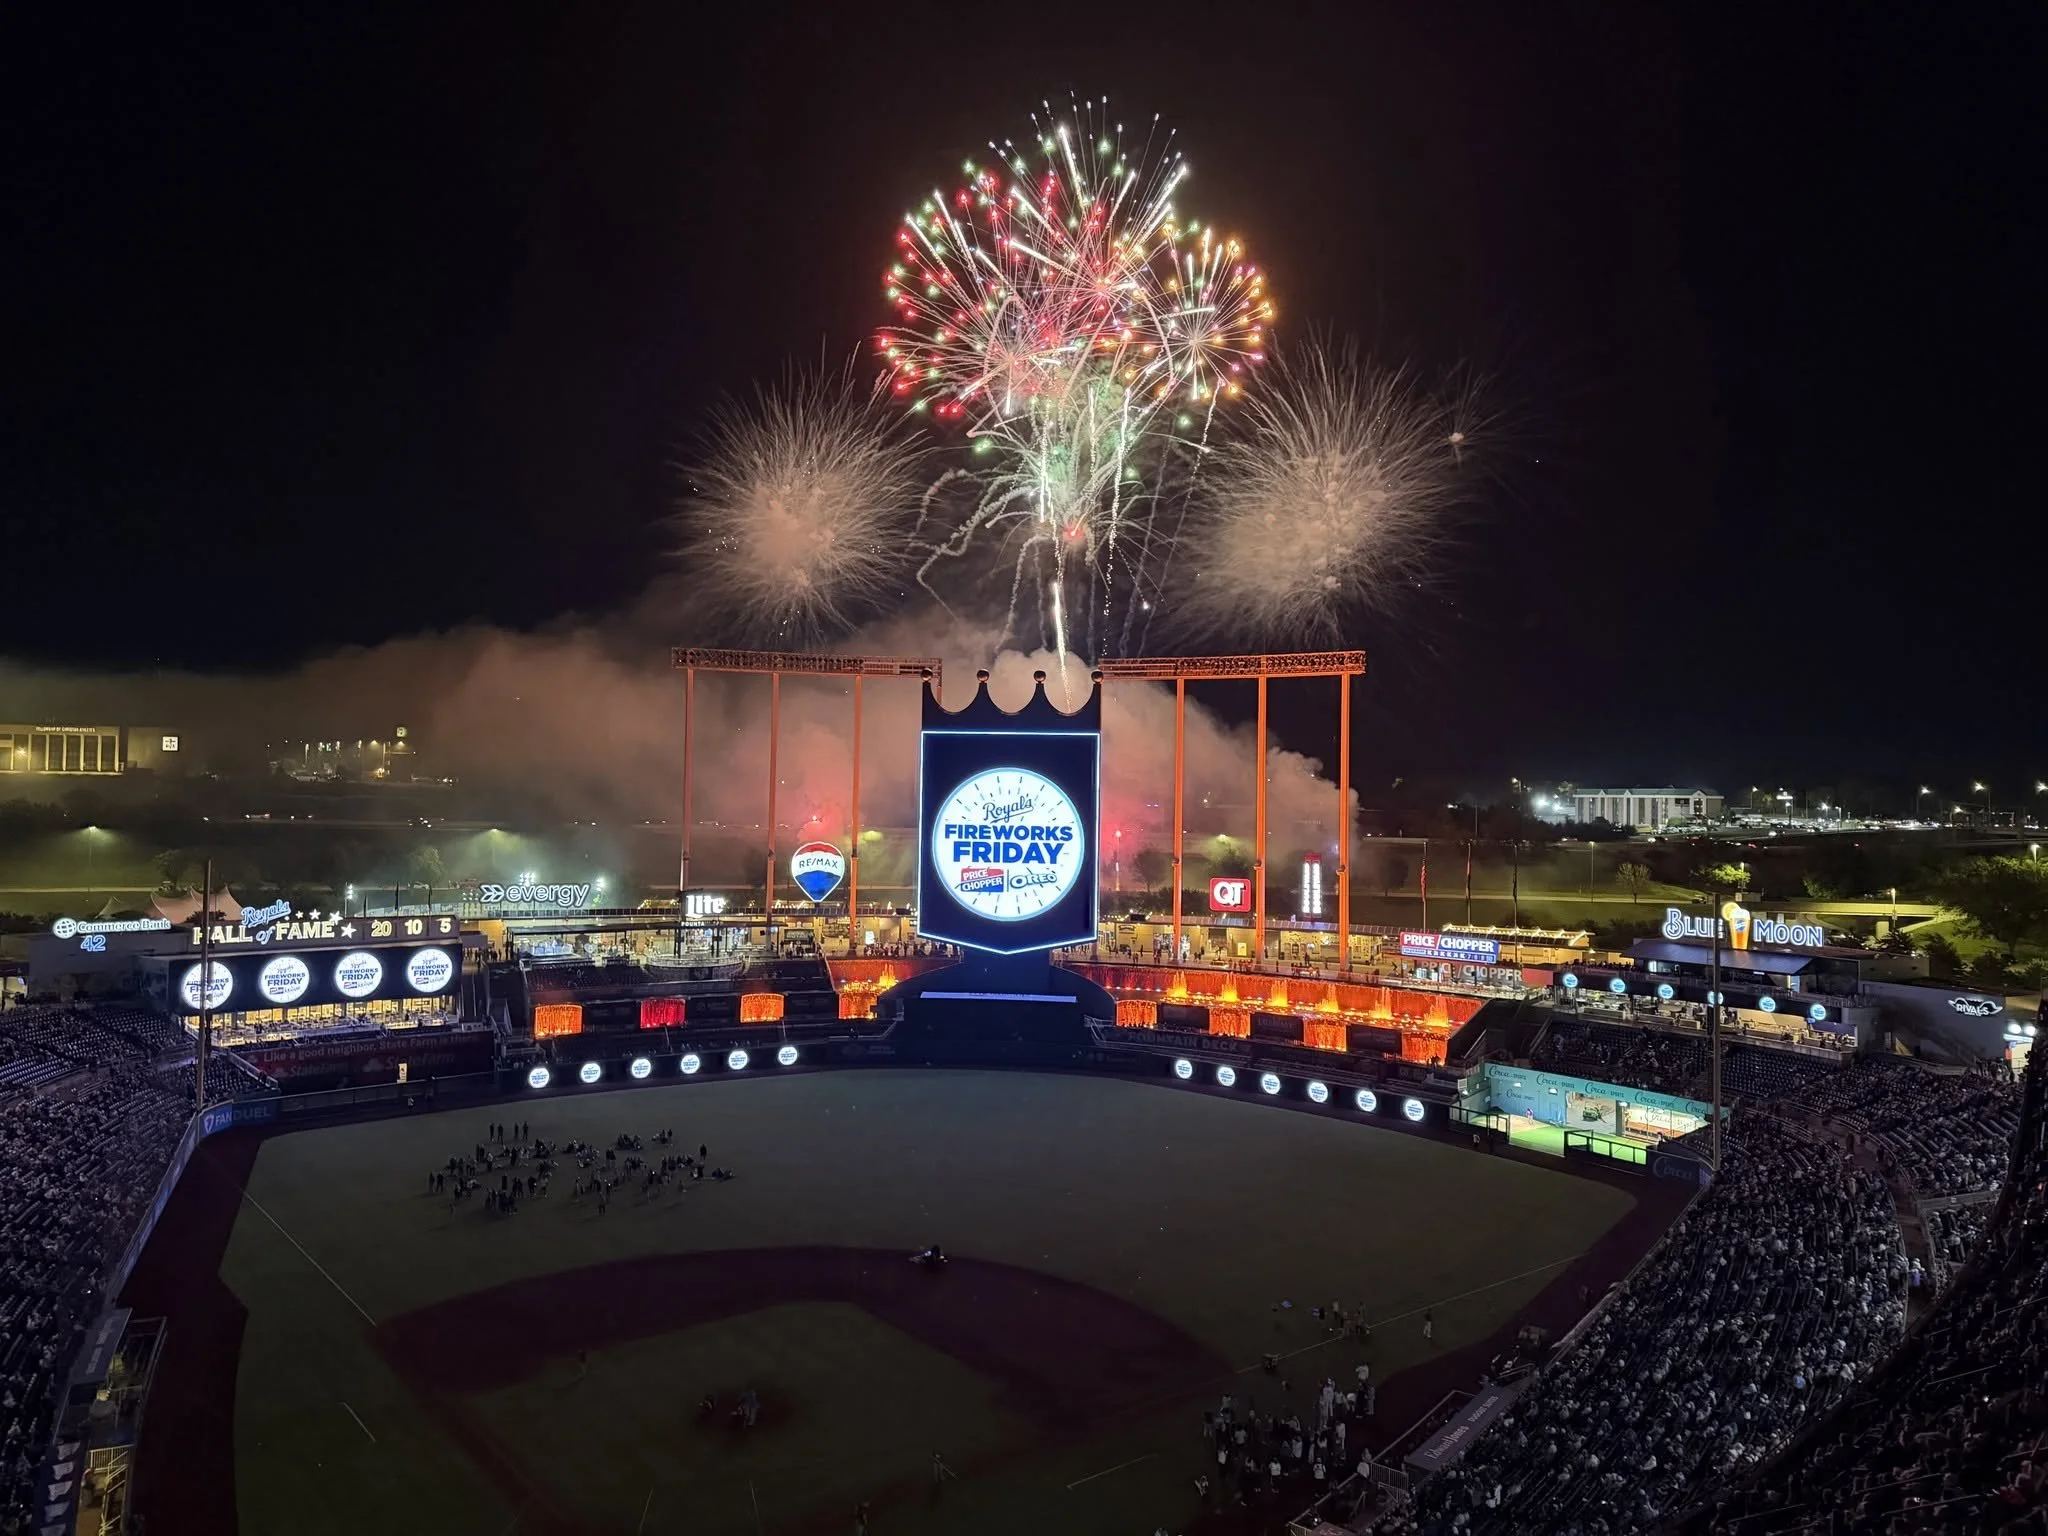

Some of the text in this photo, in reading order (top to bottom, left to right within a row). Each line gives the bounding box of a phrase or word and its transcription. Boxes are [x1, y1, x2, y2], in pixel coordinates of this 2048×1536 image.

[982, 796, 1034, 823] Royals
[944, 823, 1074, 842] FIREWORKS
[952, 841, 1065, 865] FRIDAY
[799, 857, 839, 870] RE/MAX
[962, 868, 989, 881] PRICE
[1010, 872, 1058, 889] OREO
[961, 877, 1003, 892] CHOPPER
[1213, 881, 1245, 906] QT
[505, 883, 590, 909] evergy
[241, 898, 292, 928] Royals
[77, 918, 171, 934] Commerce Bank
[255, 925, 276, 945] of
[275, 920, 336, 941] FAME
[370, 919, 393, 938] 20
[404, 918, 423, 936] 10
[439, 917, 452, 934] 5
[1752, 918, 1824, 948] MOON
[80, 934, 106, 952] 42
[1403, 934, 1436, 947] PRICE
[1440, 938, 1495, 953] CHOPPER
[341, 972, 376, 981] FRIDAY
[413, 968, 447, 977] FRIDAY
[189, 984, 226, 993] FRDAY
[267, 978, 303, 987] FRIDAY
[1955, 1003, 1990, 1016] RIVALS
[263, 1049, 287, 1063] Like
[300, 1046, 325, 1062] good
[379, 1037, 408, 1050] State
[409, 1037, 438, 1049] Farm
[215, 1105, 272, 1127] FANDUEL
